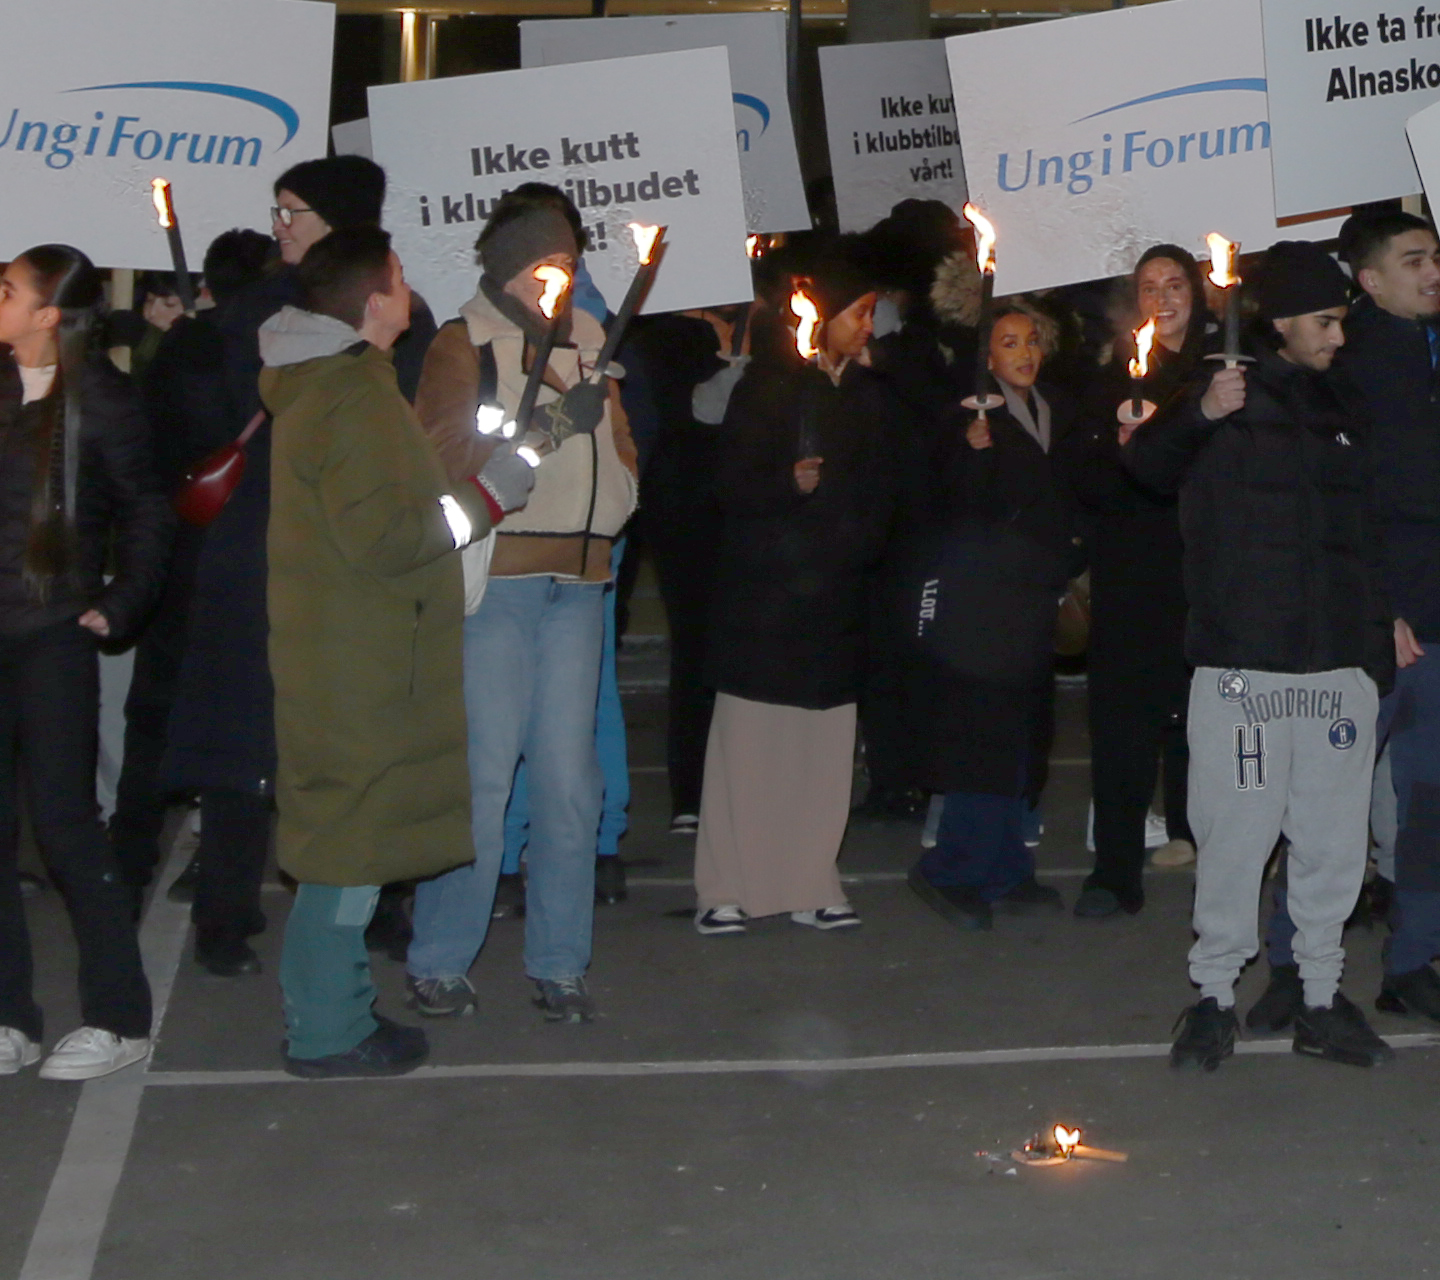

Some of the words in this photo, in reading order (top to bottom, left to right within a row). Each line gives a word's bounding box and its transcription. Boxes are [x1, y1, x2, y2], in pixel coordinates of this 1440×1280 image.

[1305, 15, 1369, 52] Ikke
[1377, 13, 1406, 44] ta
[881, 96, 923, 118] Ikke
[470, 143, 551, 176] Ikke
[561, 132, 640, 166] kutt
[853, 131, 860, 155] i
[910, 158, 954, 182] vårt!
[419, 195, 431, 226] i
[1242, 688, 1342, 727] HOODRICH
